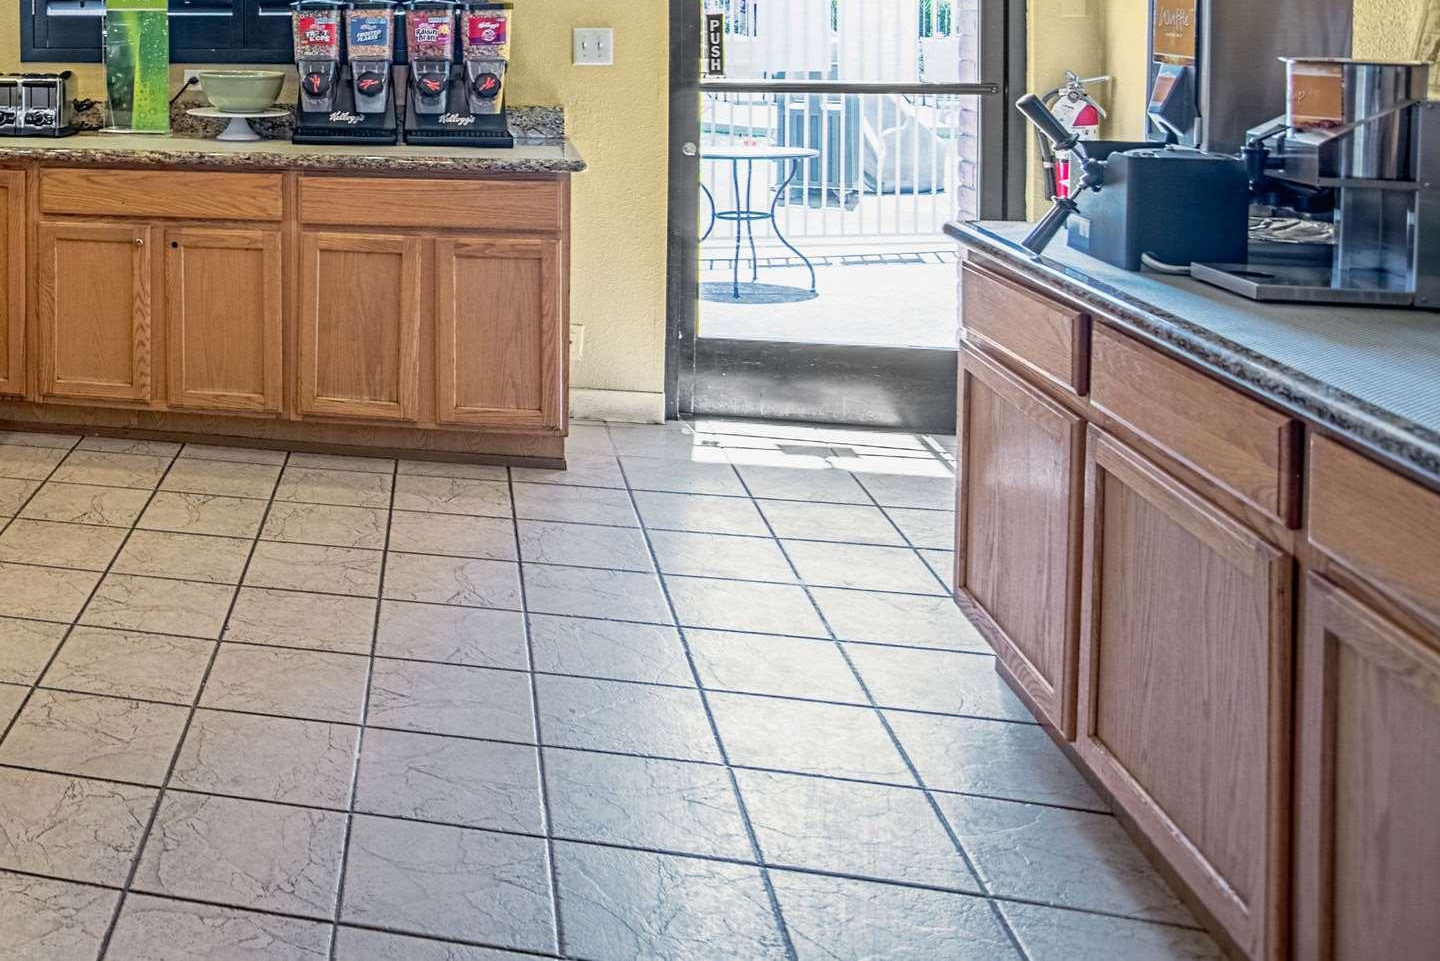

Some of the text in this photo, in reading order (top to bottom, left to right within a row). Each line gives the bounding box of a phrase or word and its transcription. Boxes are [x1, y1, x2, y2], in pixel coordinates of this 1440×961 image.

[709, 19, 721, 71] PUSH
[328, 110, 365, 125] Kellogg's
[438, 112, 476, 126] Kellogg's
